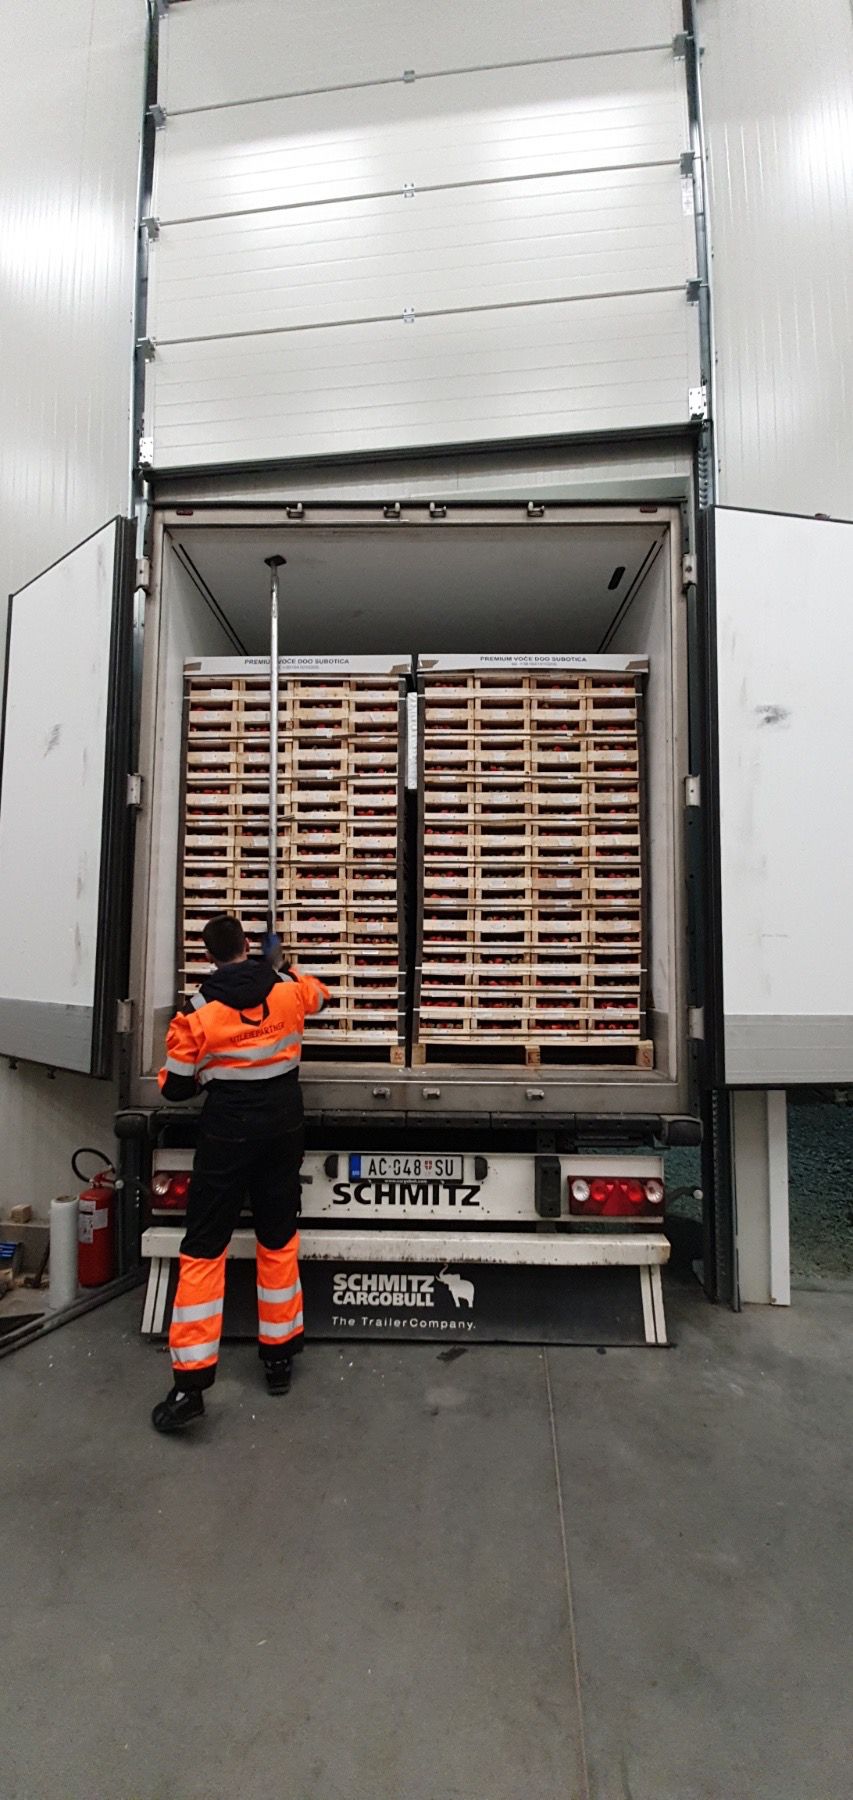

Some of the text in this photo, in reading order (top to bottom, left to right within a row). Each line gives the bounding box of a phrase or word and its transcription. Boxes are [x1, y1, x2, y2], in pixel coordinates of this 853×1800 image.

[314, 657, 350, 665] SUBOTICA
[435, 1158, 454, 1177] SU
[332, 1182, 481, 1207] SCHMITZ
[333, 1273, 435, 1293] SCHMITZ
[332, 1291, 435, 1308] CARGOBULL
[332, 1316, 356, 1327] The
